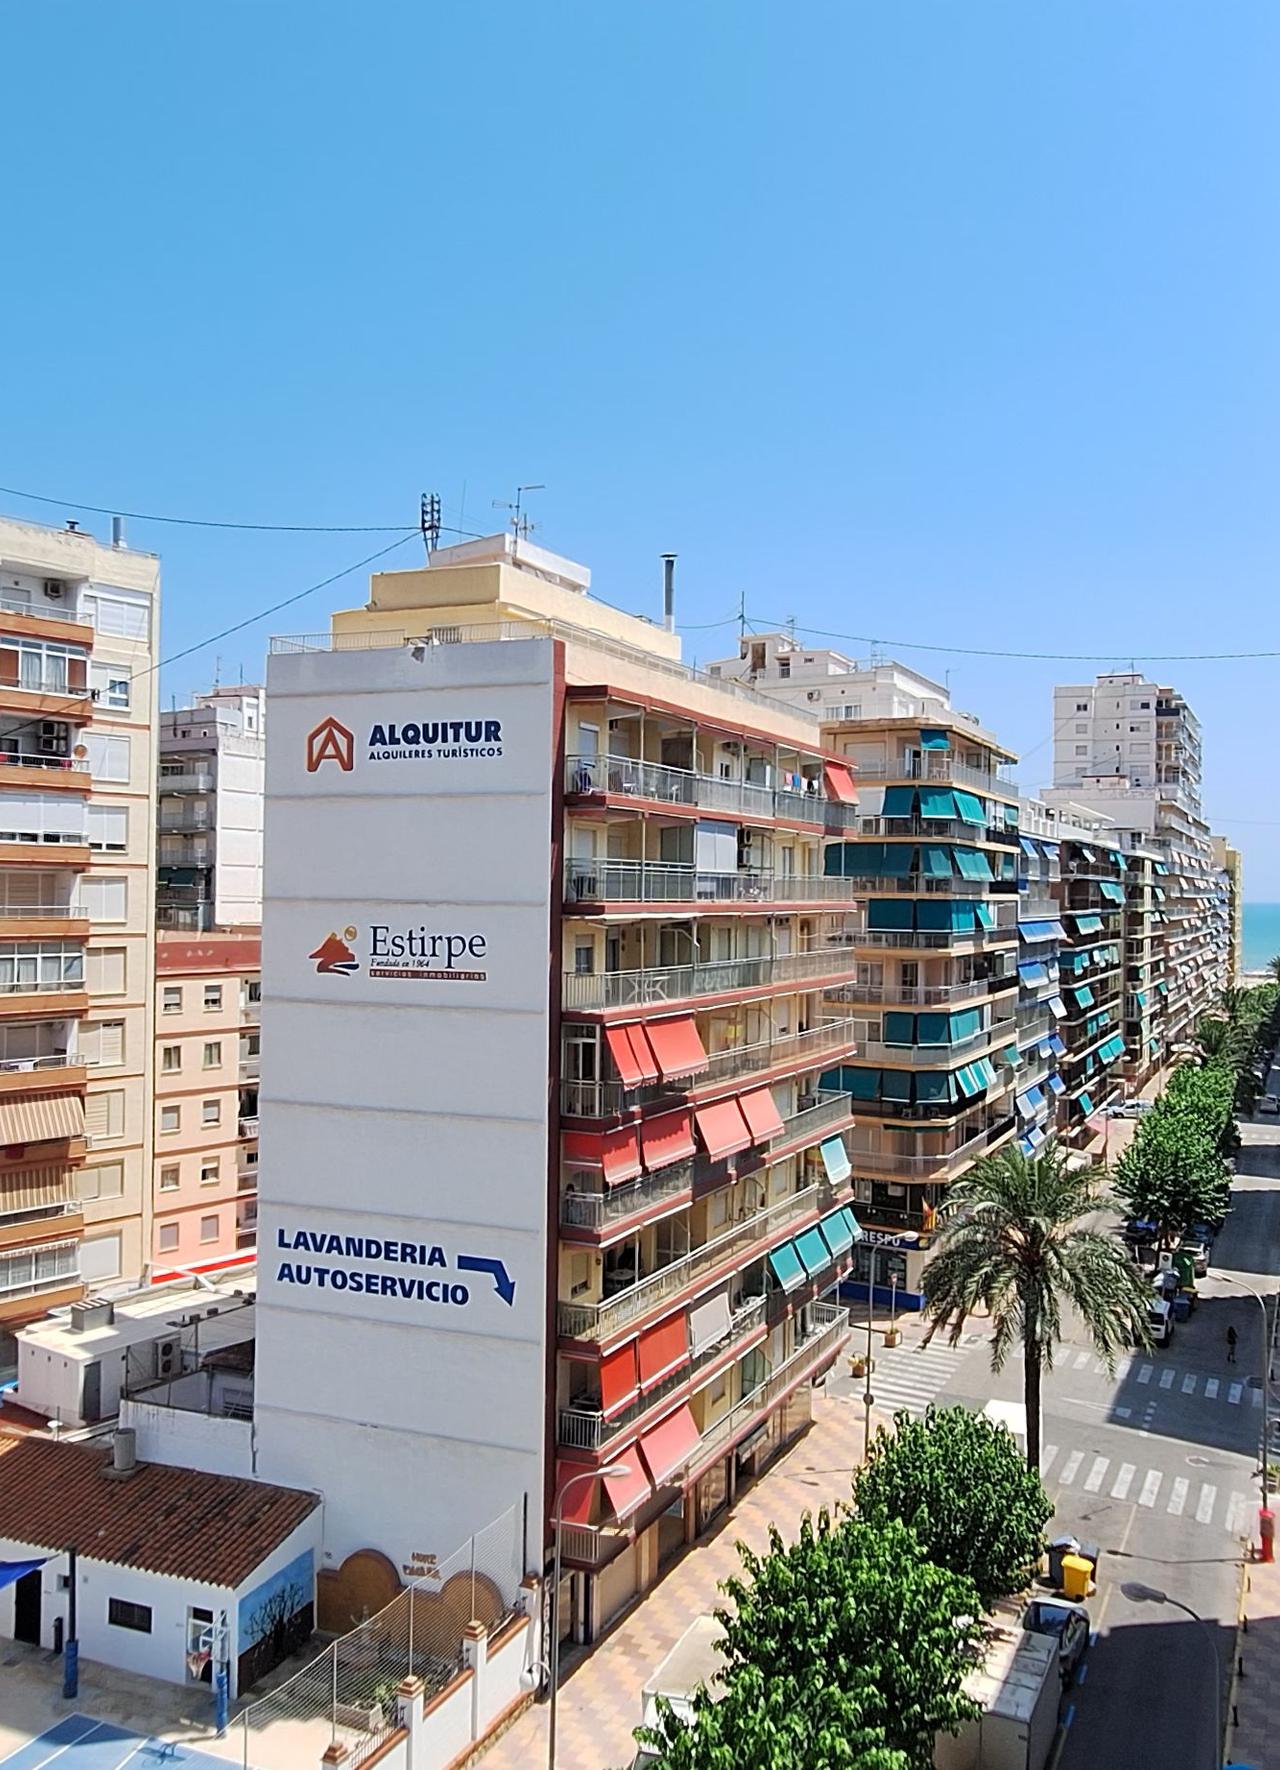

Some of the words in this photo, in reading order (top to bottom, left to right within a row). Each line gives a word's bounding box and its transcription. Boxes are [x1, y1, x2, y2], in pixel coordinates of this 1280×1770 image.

[368, 720, 502, 746] ALQUITUR
[368, 749, 433, 760] ALQUILERES
[437, 746, 503, 758] TURÍSTICOS
[369, 926, 486, 969] Estirpe
[277, 1228, 448, 1268] LAVANDERIA
[277, 1262, 470, 1306] AUTOSERVICIO
